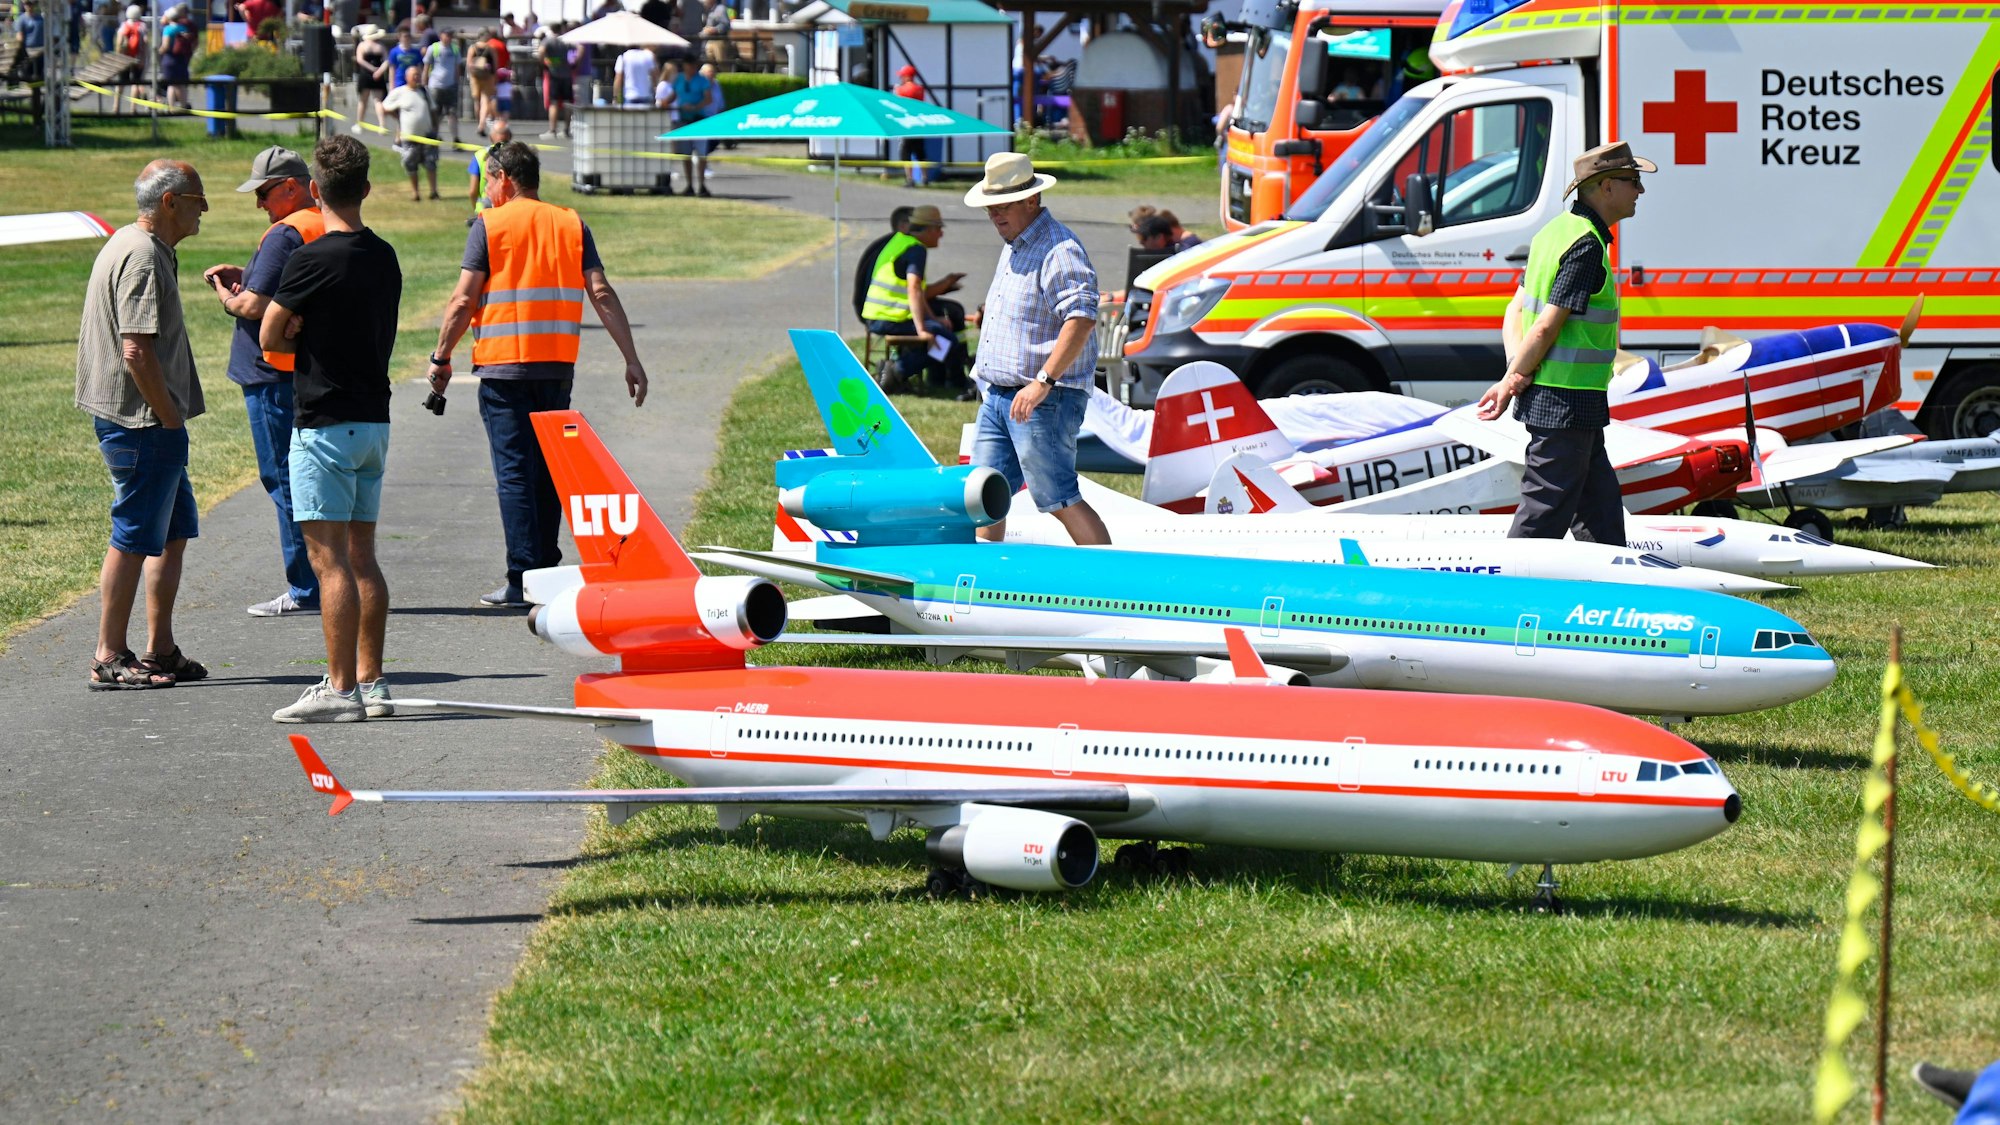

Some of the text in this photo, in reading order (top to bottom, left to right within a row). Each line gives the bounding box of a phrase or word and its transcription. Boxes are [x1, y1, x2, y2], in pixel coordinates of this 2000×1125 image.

[1761, 68, 1945, 96] Deutsches
[1761, 103, 1861, 131] Rotes
[1761, 137, 1861, 165] Kreuz
[1798, 487, 1827, 497] NAVY
[569, 493, 640, 537] LTU
[707, 609, 729, 619] TriJet
[916, 611, 941, 621] N272WA
[1564, 603, 1696, 637] Aer Lingus
[734, 702, 769, 713] D-AERB
[311, 773, 335, 789] LTU
[1601, 770, 1628, 783] LTU
[1023, 844, 1043, 855] LTU
[1023, 856, 1043, 866] TriJet
